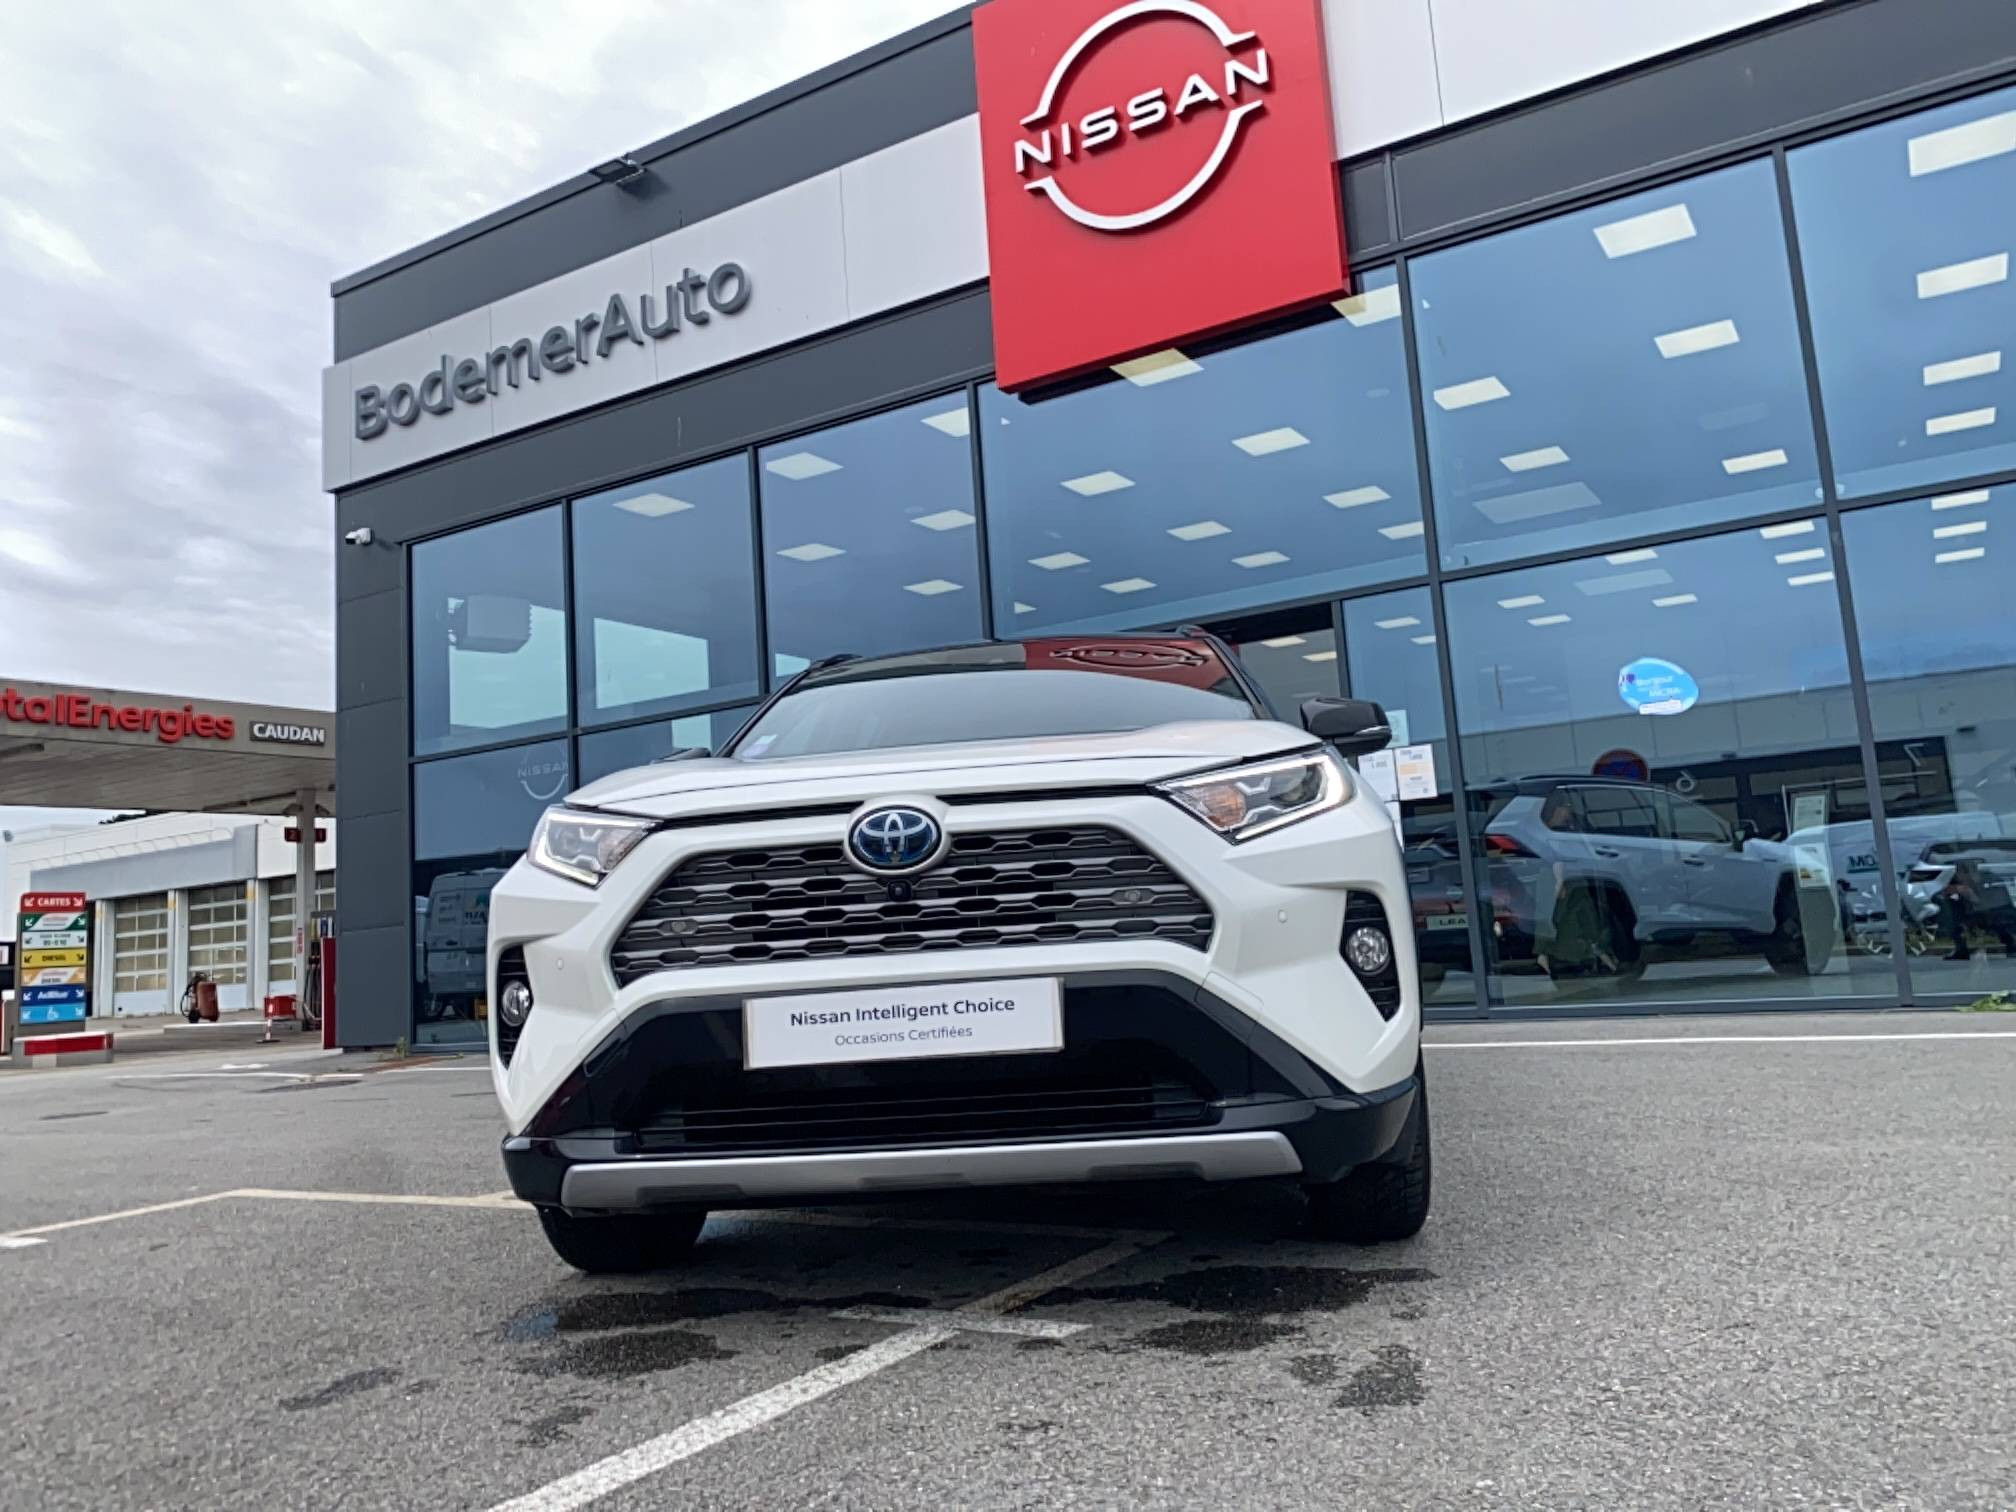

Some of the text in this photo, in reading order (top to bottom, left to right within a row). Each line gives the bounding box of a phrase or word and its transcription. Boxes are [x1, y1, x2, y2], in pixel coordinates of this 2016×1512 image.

[1013, 47, 1269, 173] NISSAN
[355, 262, 752, 440] BodemerAuto
[0, 687, 236, 743] talEnergies
[252, 722, 326, 742] CAUDAN
[37, 897, 71, 907] CARTES
[790, 997, 1016, 1026] Nissan Intelligent Choice
[834, 1025, 974, 1046] Occasions Certifiées
